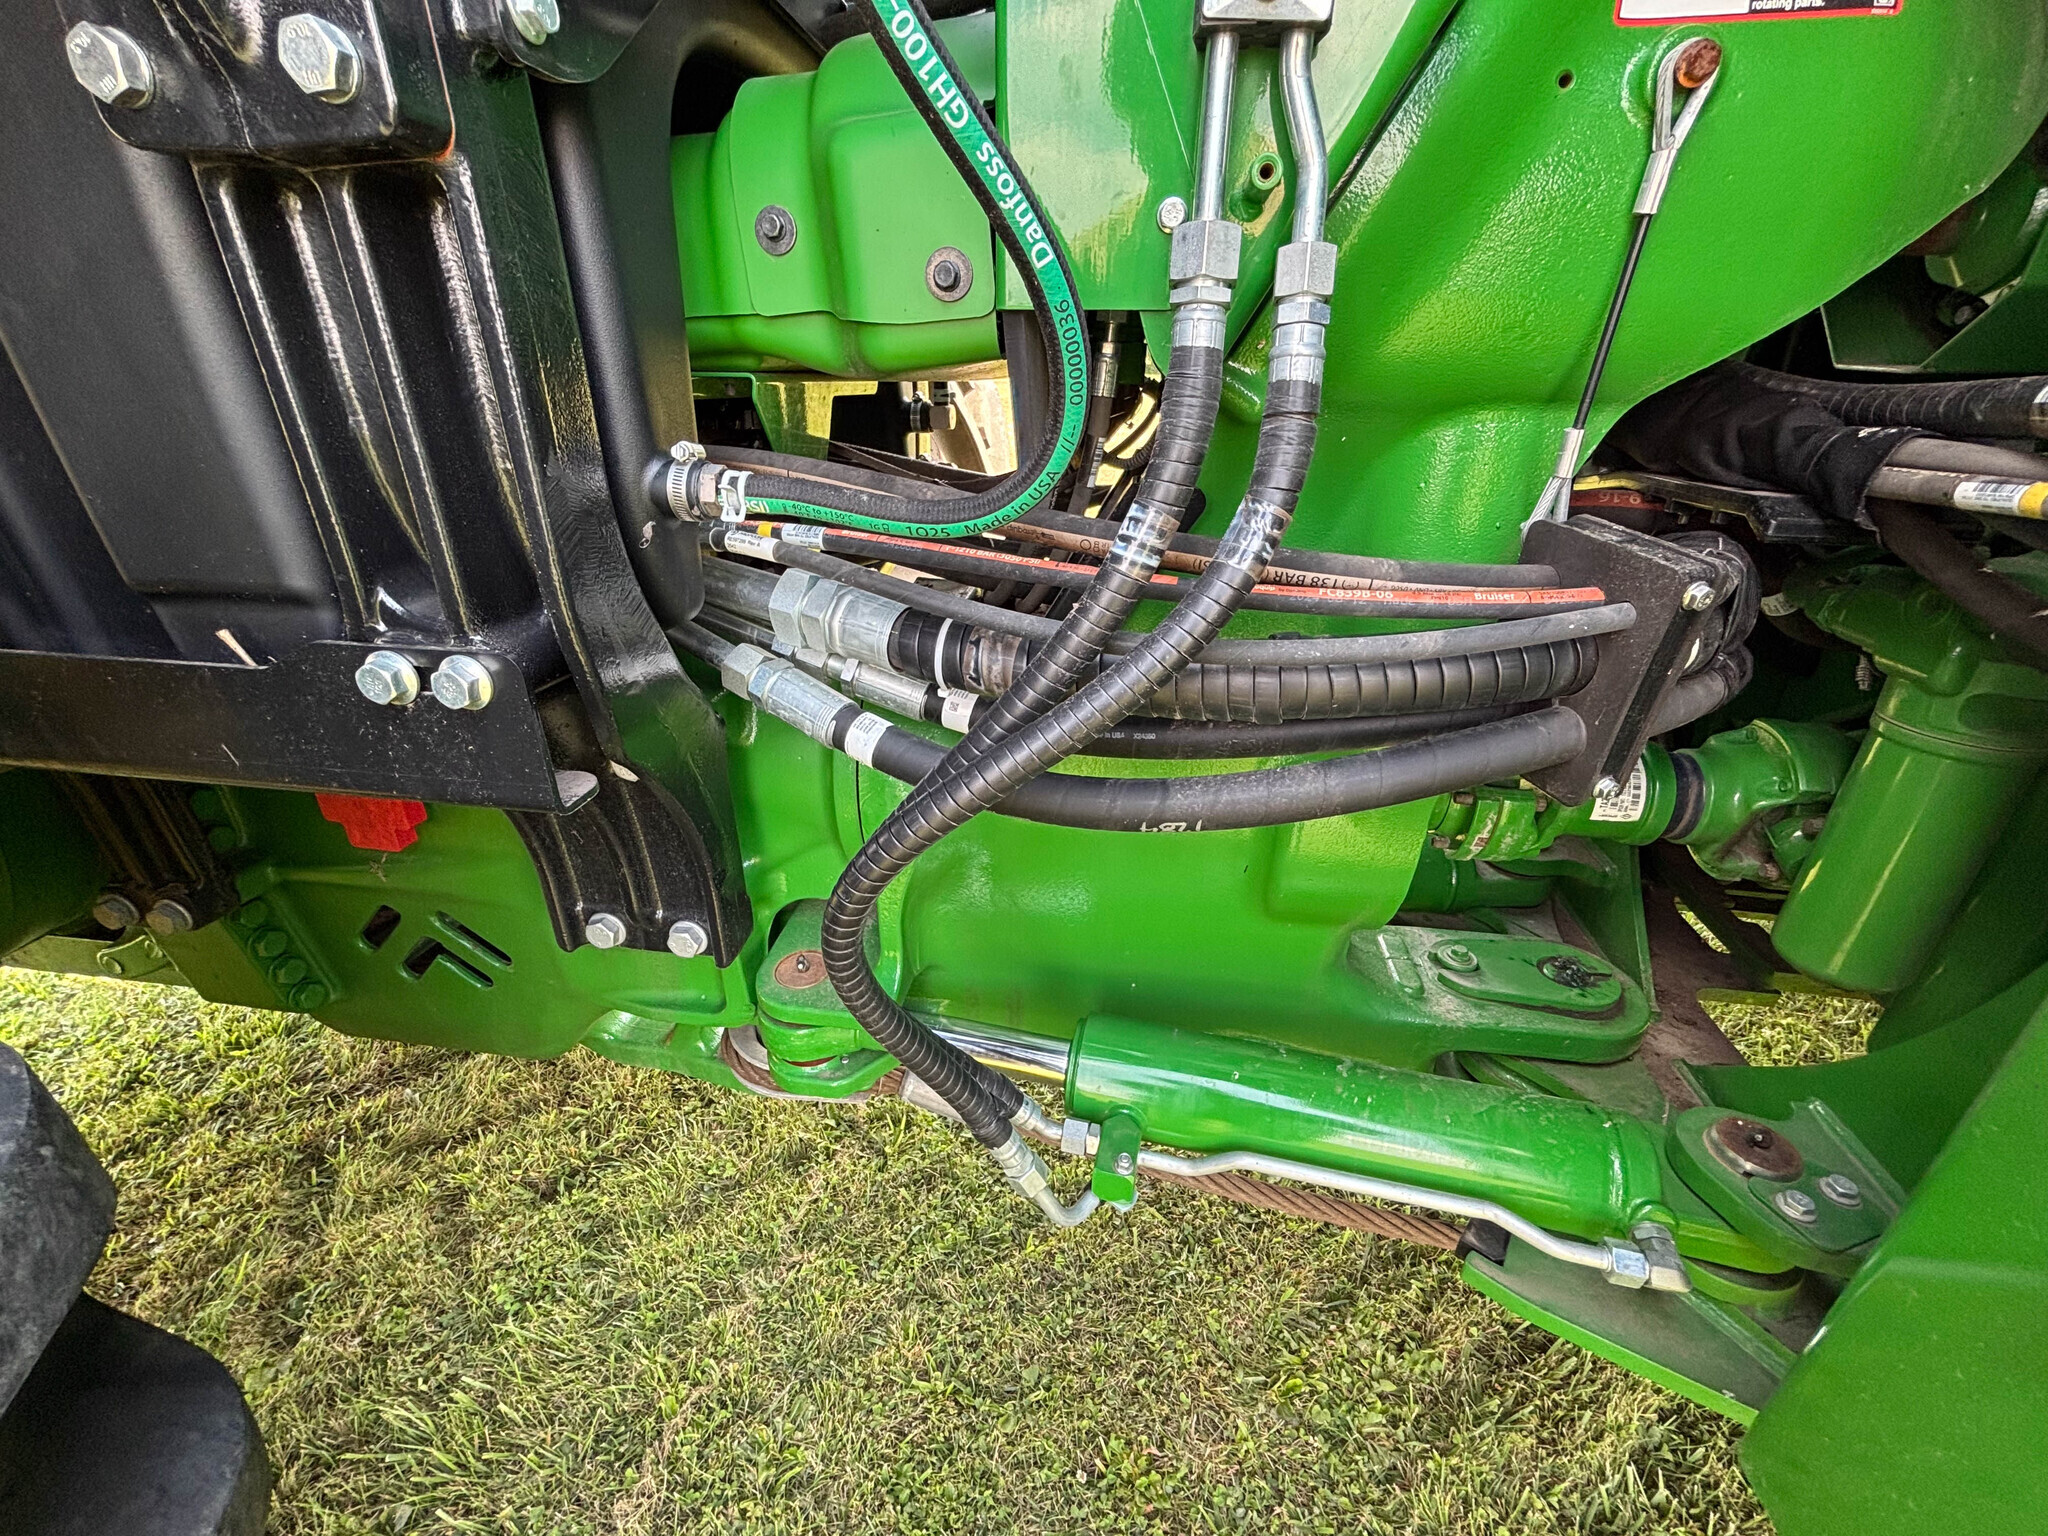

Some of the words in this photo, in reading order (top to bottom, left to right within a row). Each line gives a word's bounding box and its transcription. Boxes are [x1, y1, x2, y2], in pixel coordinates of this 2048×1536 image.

[976, 141, 1054, 269] Danfoss
[964, 514, 1013, 535] Made
[1011, 501, 1031, 518] in
[1033, 470, 1061, 501] USA
[1054, 299, 1084, 406] 00000036
[1273, 570, 1306, 586] BAR
[1474, 592, 1516, 601] Bruiser
